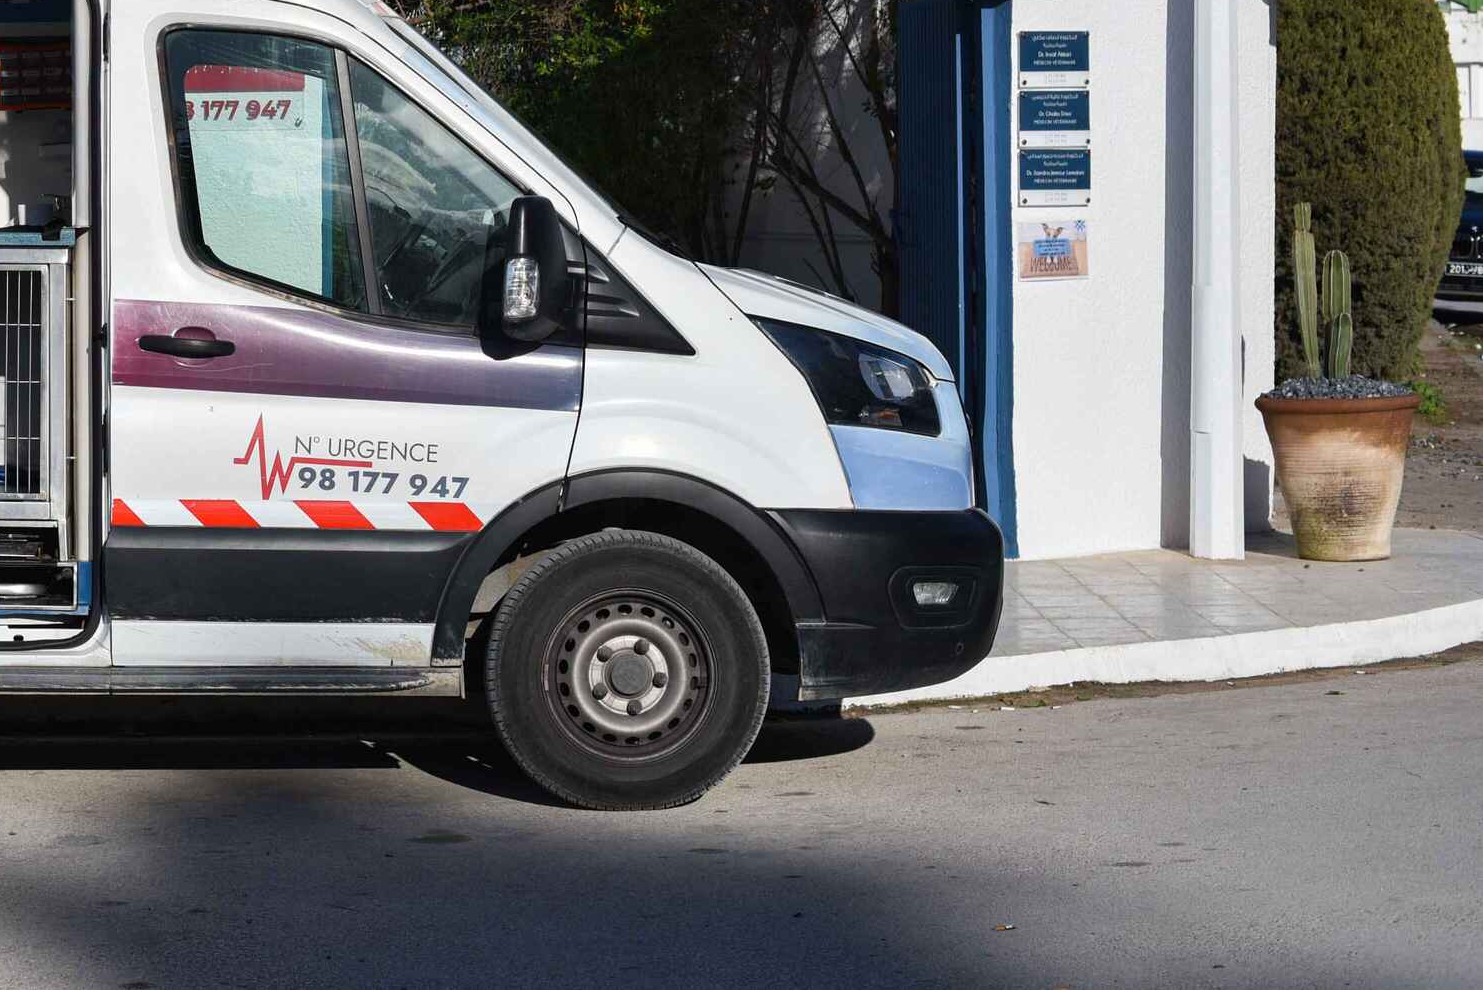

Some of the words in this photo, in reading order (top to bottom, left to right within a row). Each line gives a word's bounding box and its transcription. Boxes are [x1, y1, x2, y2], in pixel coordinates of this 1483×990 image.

[201, 100, 239, 121] 177
[245, 99, 292, 121] 947
[328, 437, 439, 463] URGENCE
[298, 466, 336, 491] 98
[348, 470, 399, 494] 177
[408, 473, 470, 499] 947
